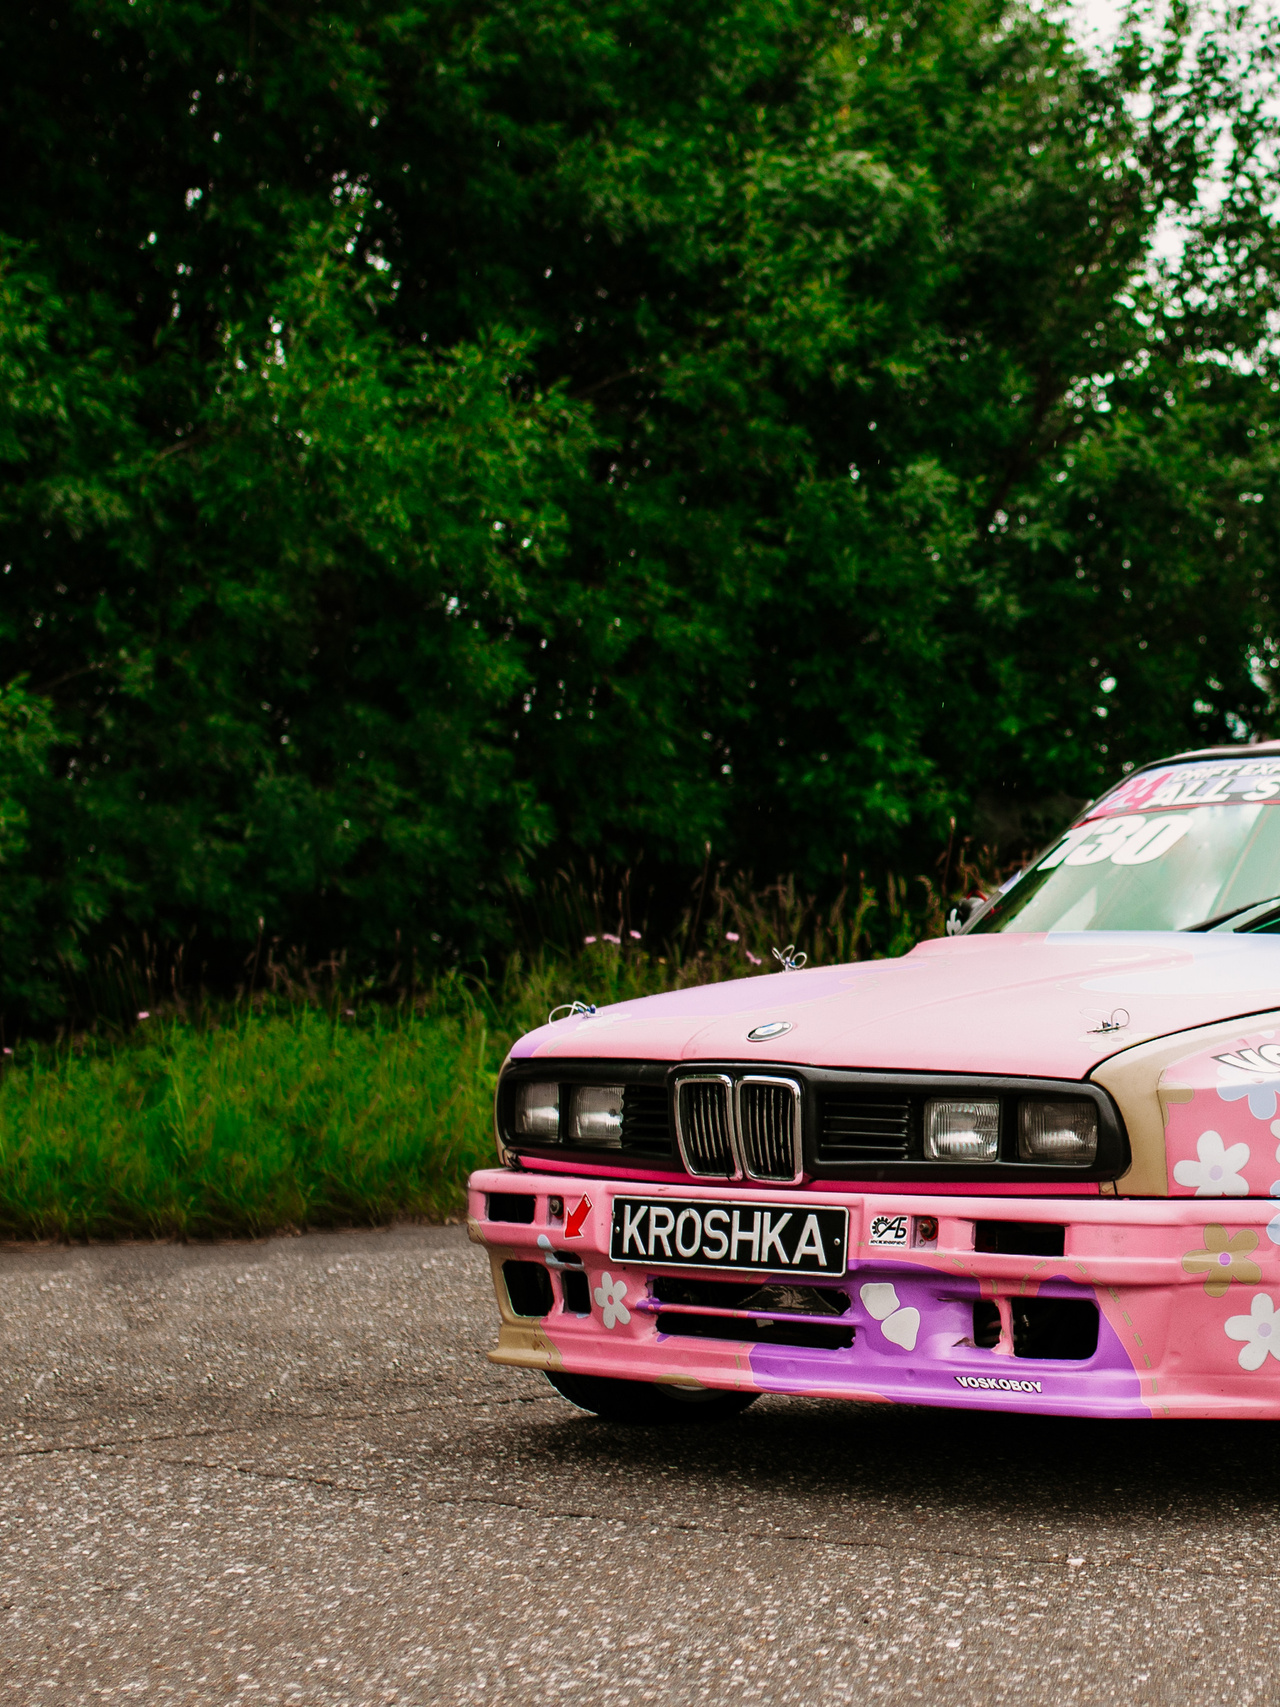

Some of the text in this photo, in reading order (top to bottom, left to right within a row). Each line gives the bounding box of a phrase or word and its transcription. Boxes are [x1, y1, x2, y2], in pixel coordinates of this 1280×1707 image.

[1170, 764, 1239, 783] DRIFT
[1138, 777, 1235, 809] ALL
[1036, 814, 1194, 871] 130
[622, 1204, 828, 1267] KROSHKA
[953, 1375, 1043, 1394] VOSKOBOY
